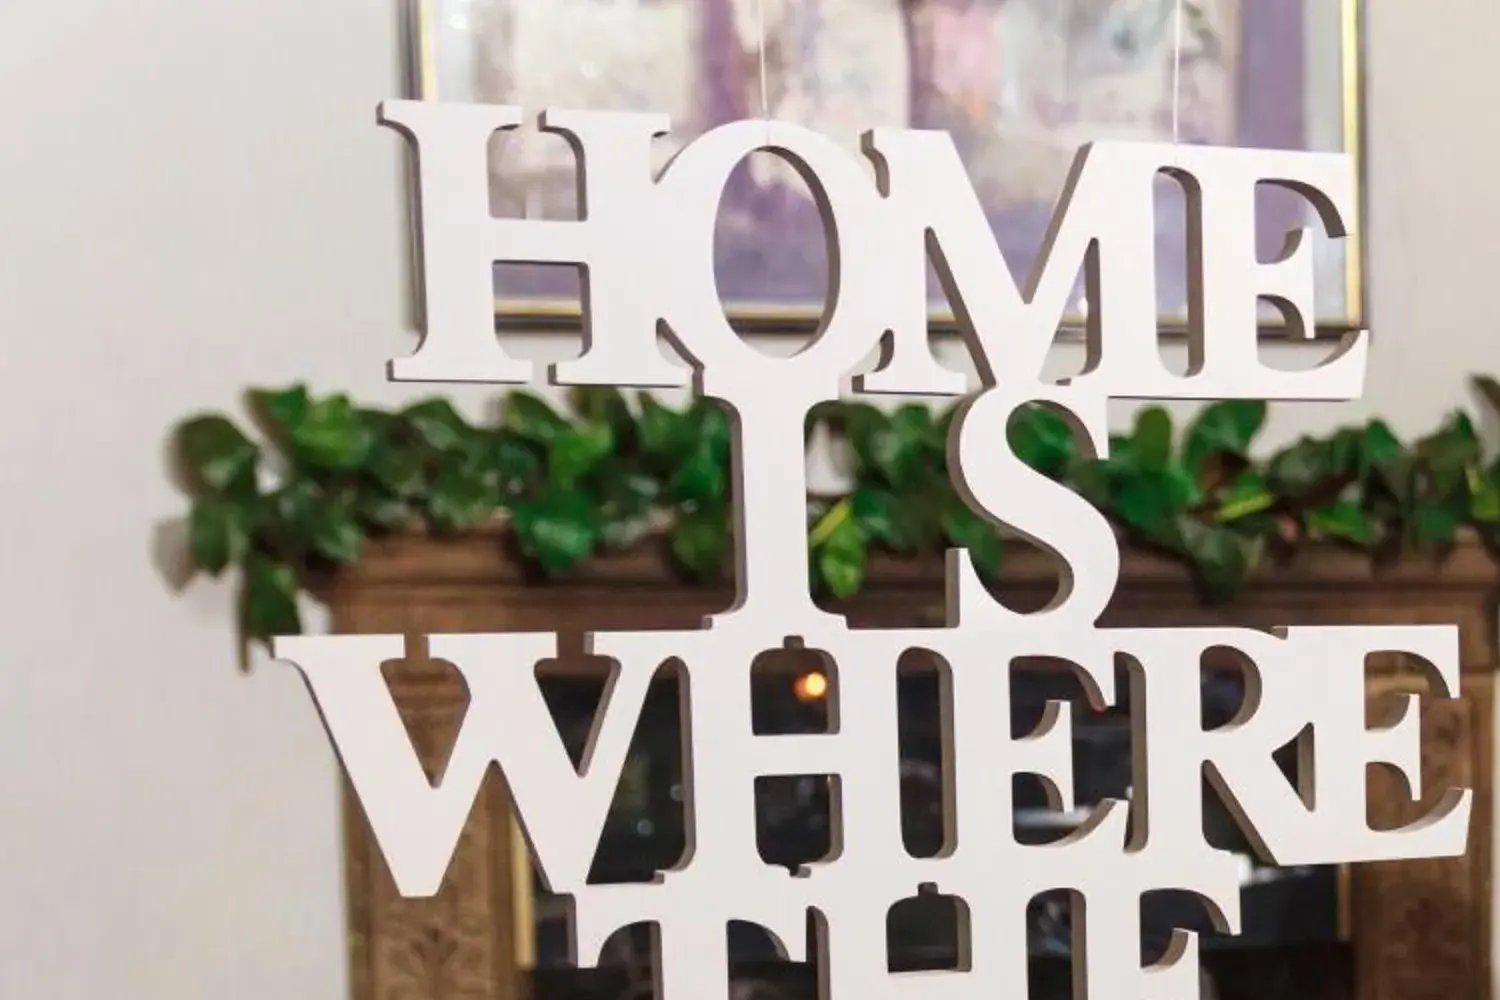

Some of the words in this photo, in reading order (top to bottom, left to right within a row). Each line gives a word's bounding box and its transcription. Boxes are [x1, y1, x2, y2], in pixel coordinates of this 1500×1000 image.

[377, 99, 1370, 402] HOME
[703, 384, 1122, 630] IS
[272, 624, 1472, 898] WHERE
